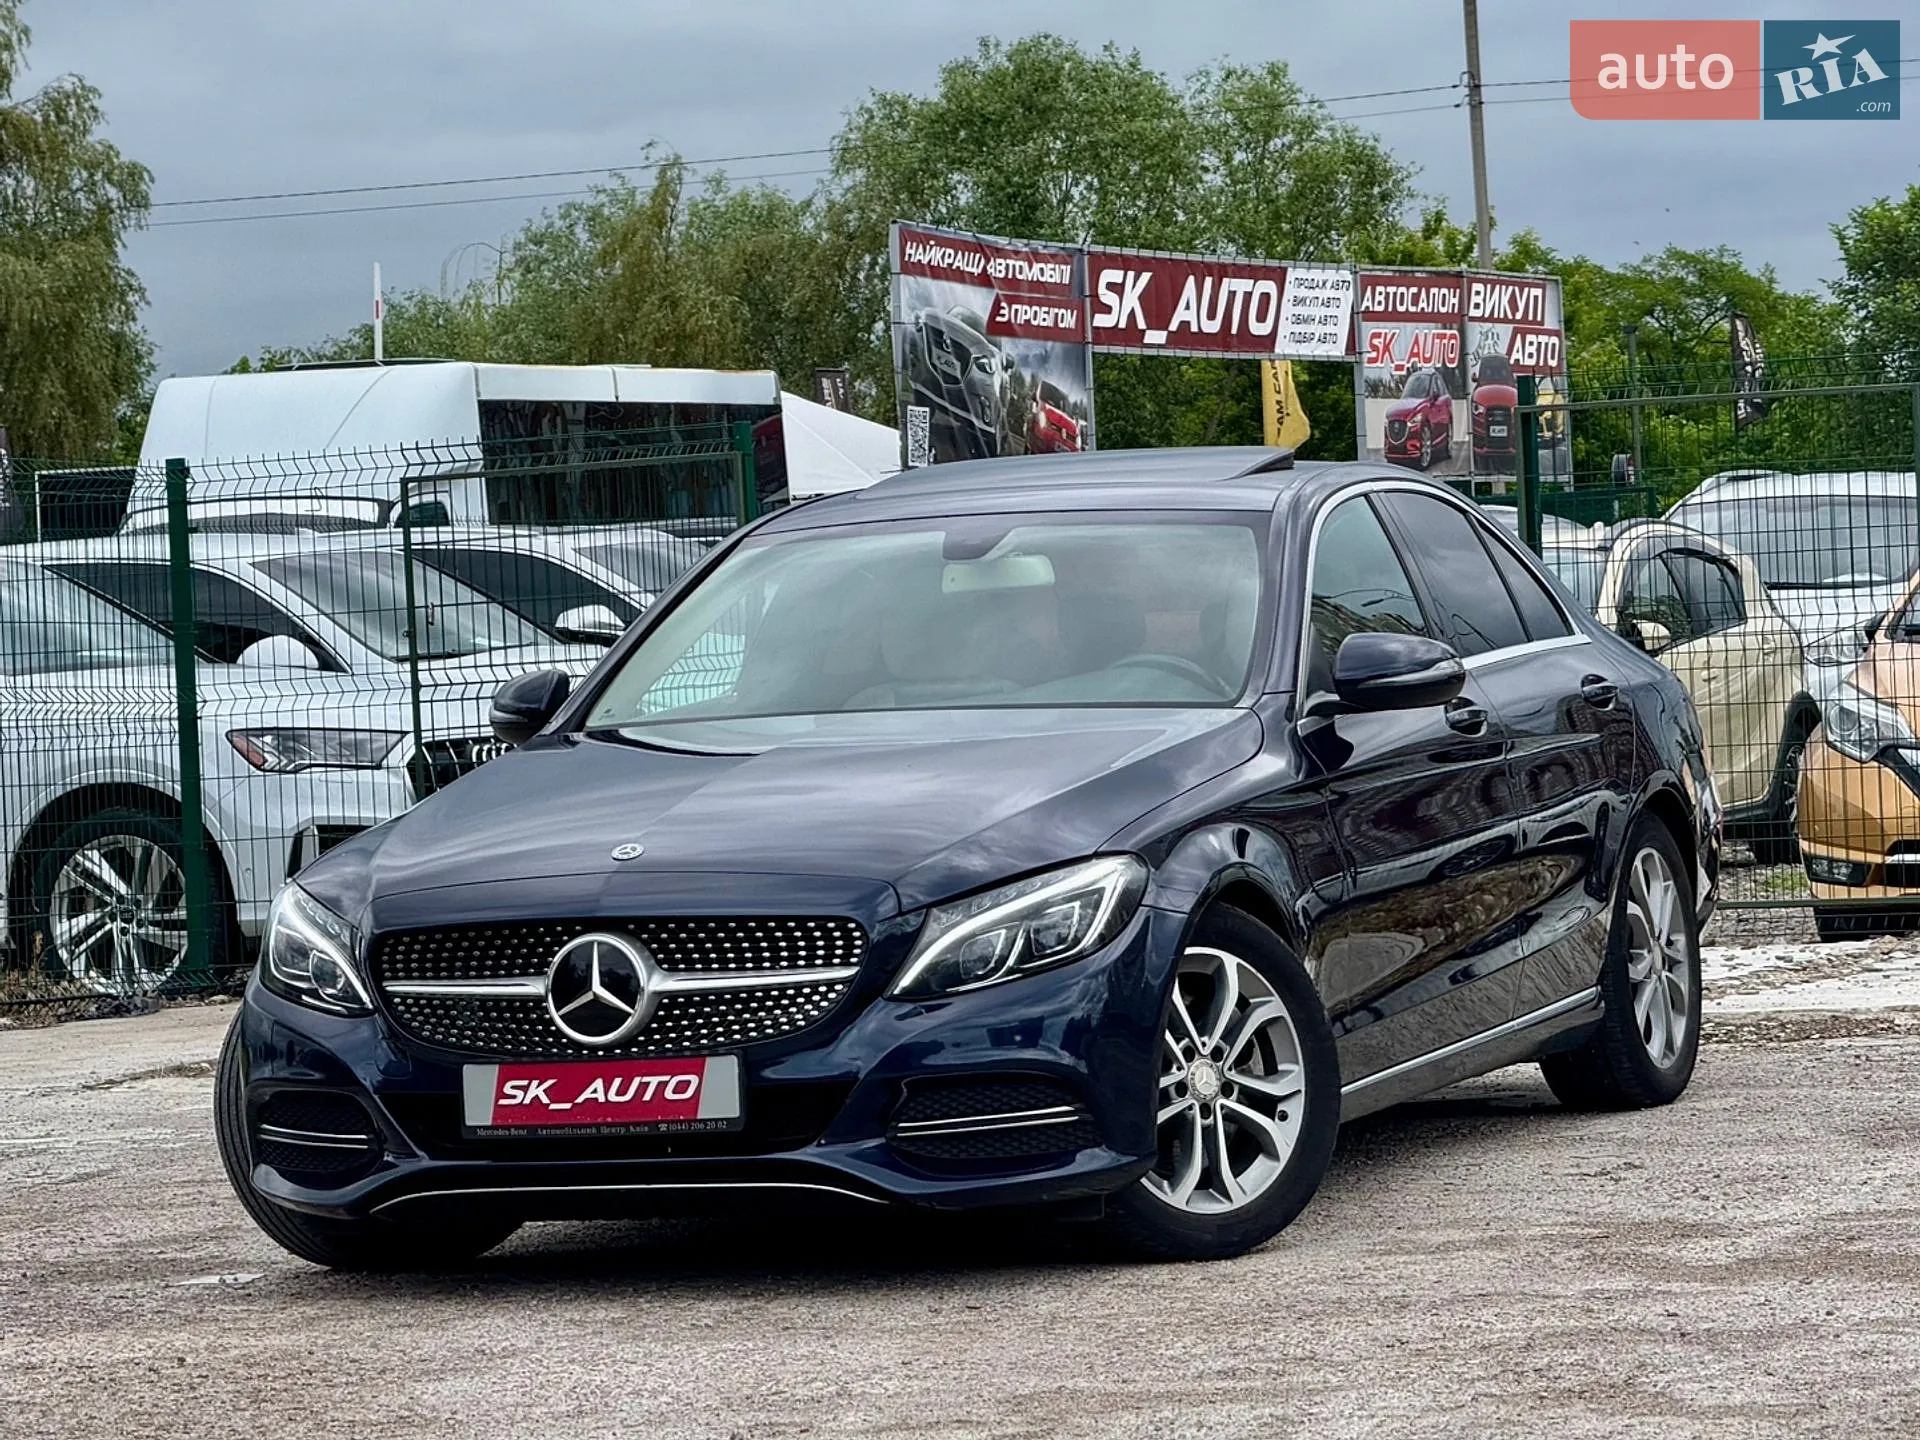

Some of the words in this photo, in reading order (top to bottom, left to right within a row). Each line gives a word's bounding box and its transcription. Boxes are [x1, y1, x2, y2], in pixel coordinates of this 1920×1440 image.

[905, 239, 985, 275] НАЙКРАЩІ
[986, 254, 1072, 286] АВТОМОБІЛІ
[1293, 277, 1328, 291] ПРОДАЖ
[1329, 279, 1351, 291] АВТО
[1093, 267, 1278, 344] SK_AUTO
[1291, 295, 1320, 308] ВИКУП
[1320, 297, 1341, 309] АВТО
[1361, 285, 1460, 315] АВТОСАЛОН
[1469, 283, 1543, 322] ВИКУП
[995, 303, 1008, 322] З
[1010, 303, 1078, 330] ПРОБІГОМ
[1290, 313, 1316, 325] ОБМІН
[1317, 314, 1339, 326] АВТО
[1288, 331, 1316, 345] ПІДБІР
[1316, 333, 1338, 344] АВТО
[1365, 328, 1460, 374] SK_AUTO
[1509, 335, 1560, 367] АВТО
[497, 1074, 700, 1110] SK_AUTO
[476, 1127, 528, 1137] Mercedes-Benz
[690, 1121, 705, 1130] 206
[706, 1120, 715, 1129] 20
[717, 1120, 727, 1129] 02
